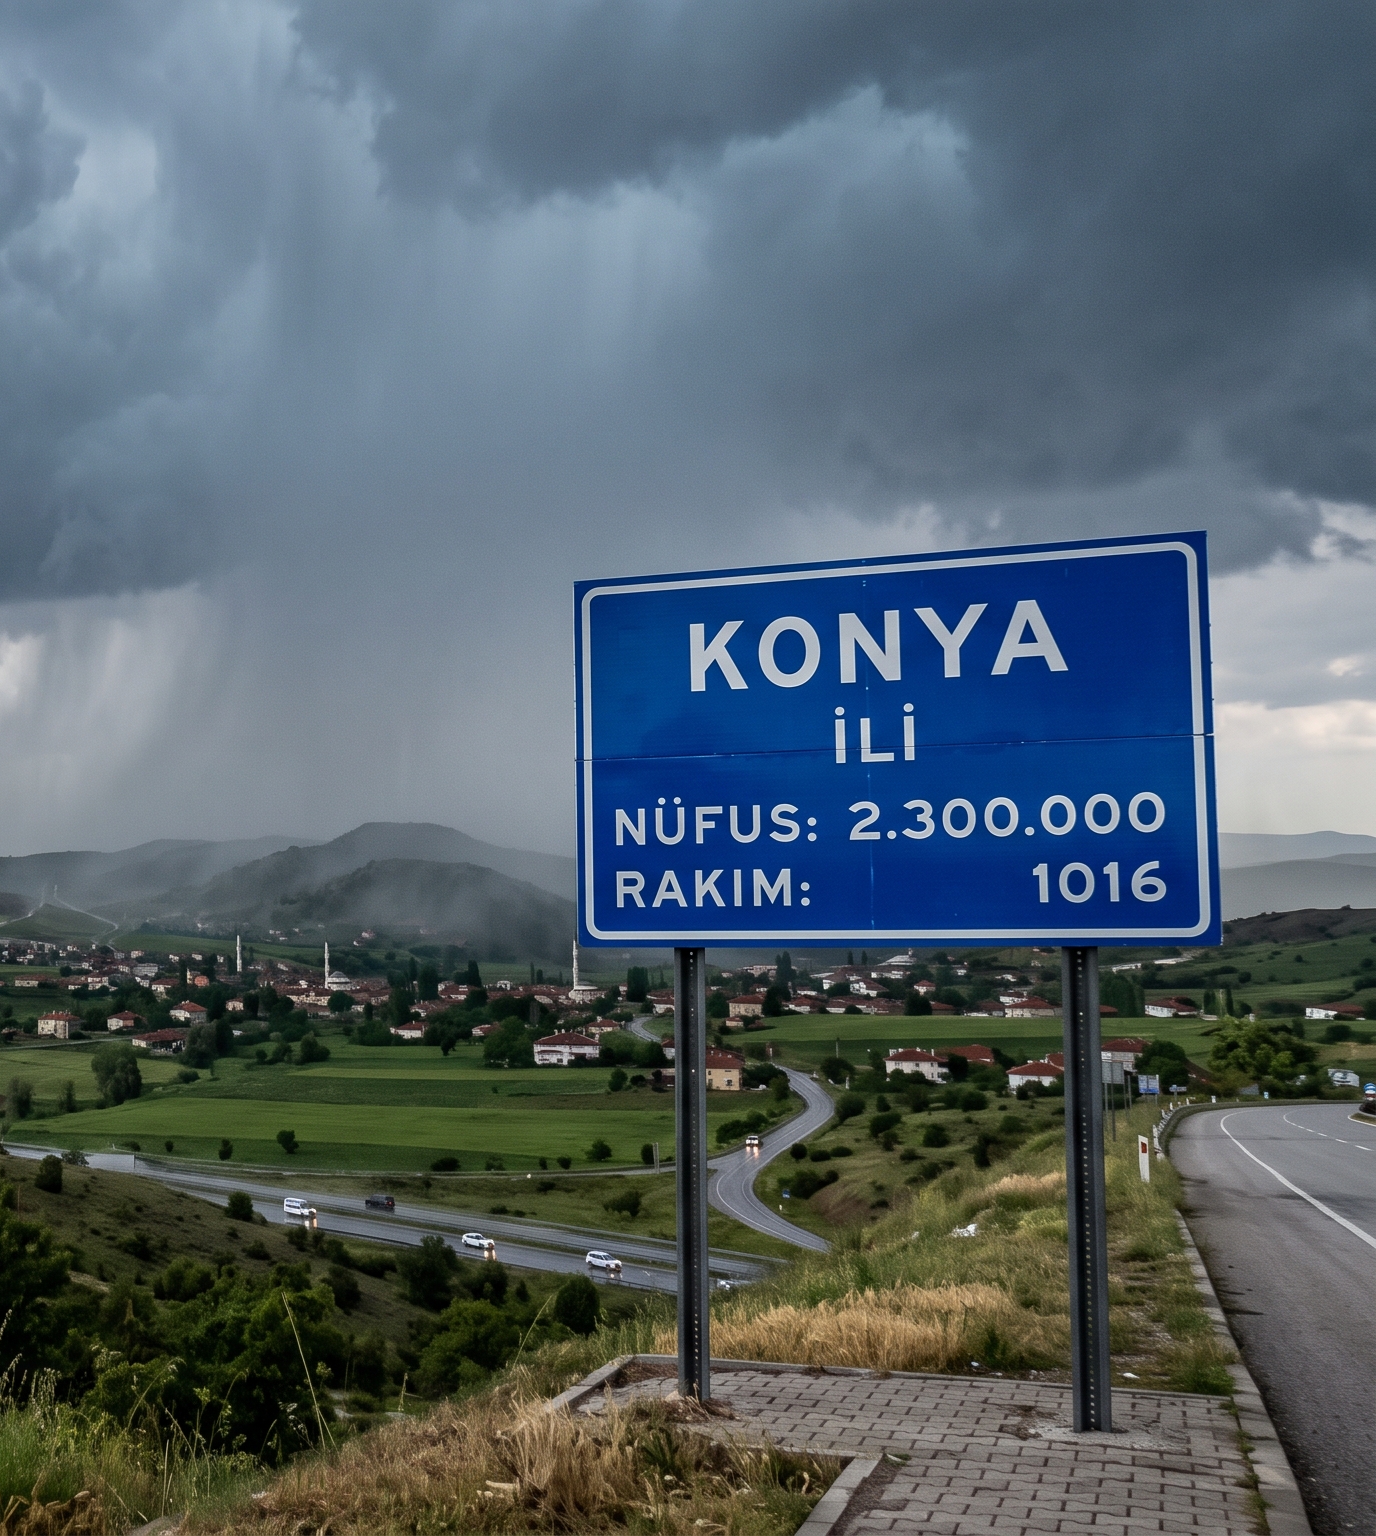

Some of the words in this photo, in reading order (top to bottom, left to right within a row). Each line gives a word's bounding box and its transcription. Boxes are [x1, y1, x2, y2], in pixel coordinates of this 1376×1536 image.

[690, 599, 1069, 692] KONYA
[834, 702, 916, 764] İLİ
[615, 796, 817, 846] NÜFUS:
[848, 791, 1167, 841] 2.300.000
[616, 868, 811, 908] RAKIM:
[1032, 860, 1167, 904] 1016
